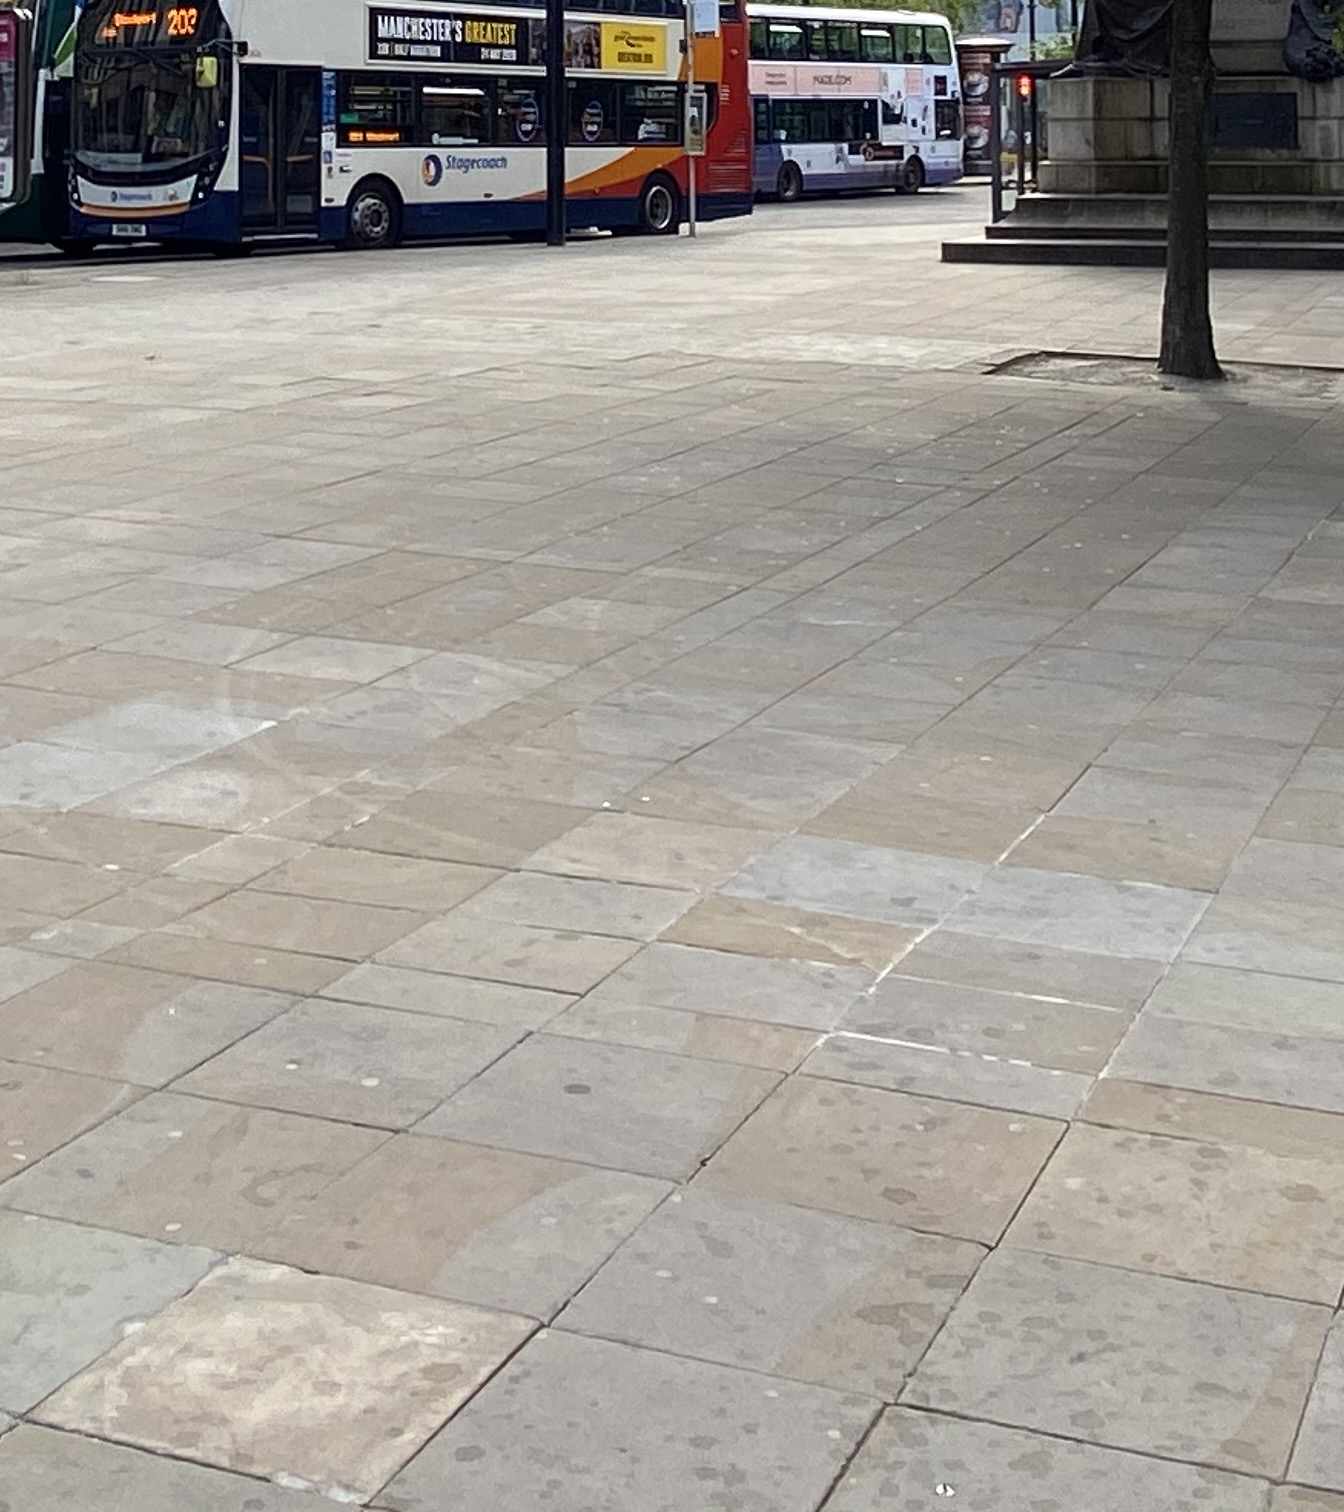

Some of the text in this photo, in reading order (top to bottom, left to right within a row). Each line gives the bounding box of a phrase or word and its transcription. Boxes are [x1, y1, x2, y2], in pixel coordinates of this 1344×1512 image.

[167, 8, 197, 36] 203
[377, 15, 517, 45] MANCHESTER'S GREATEST
[446, 154, 508, 174] Stagecoach
